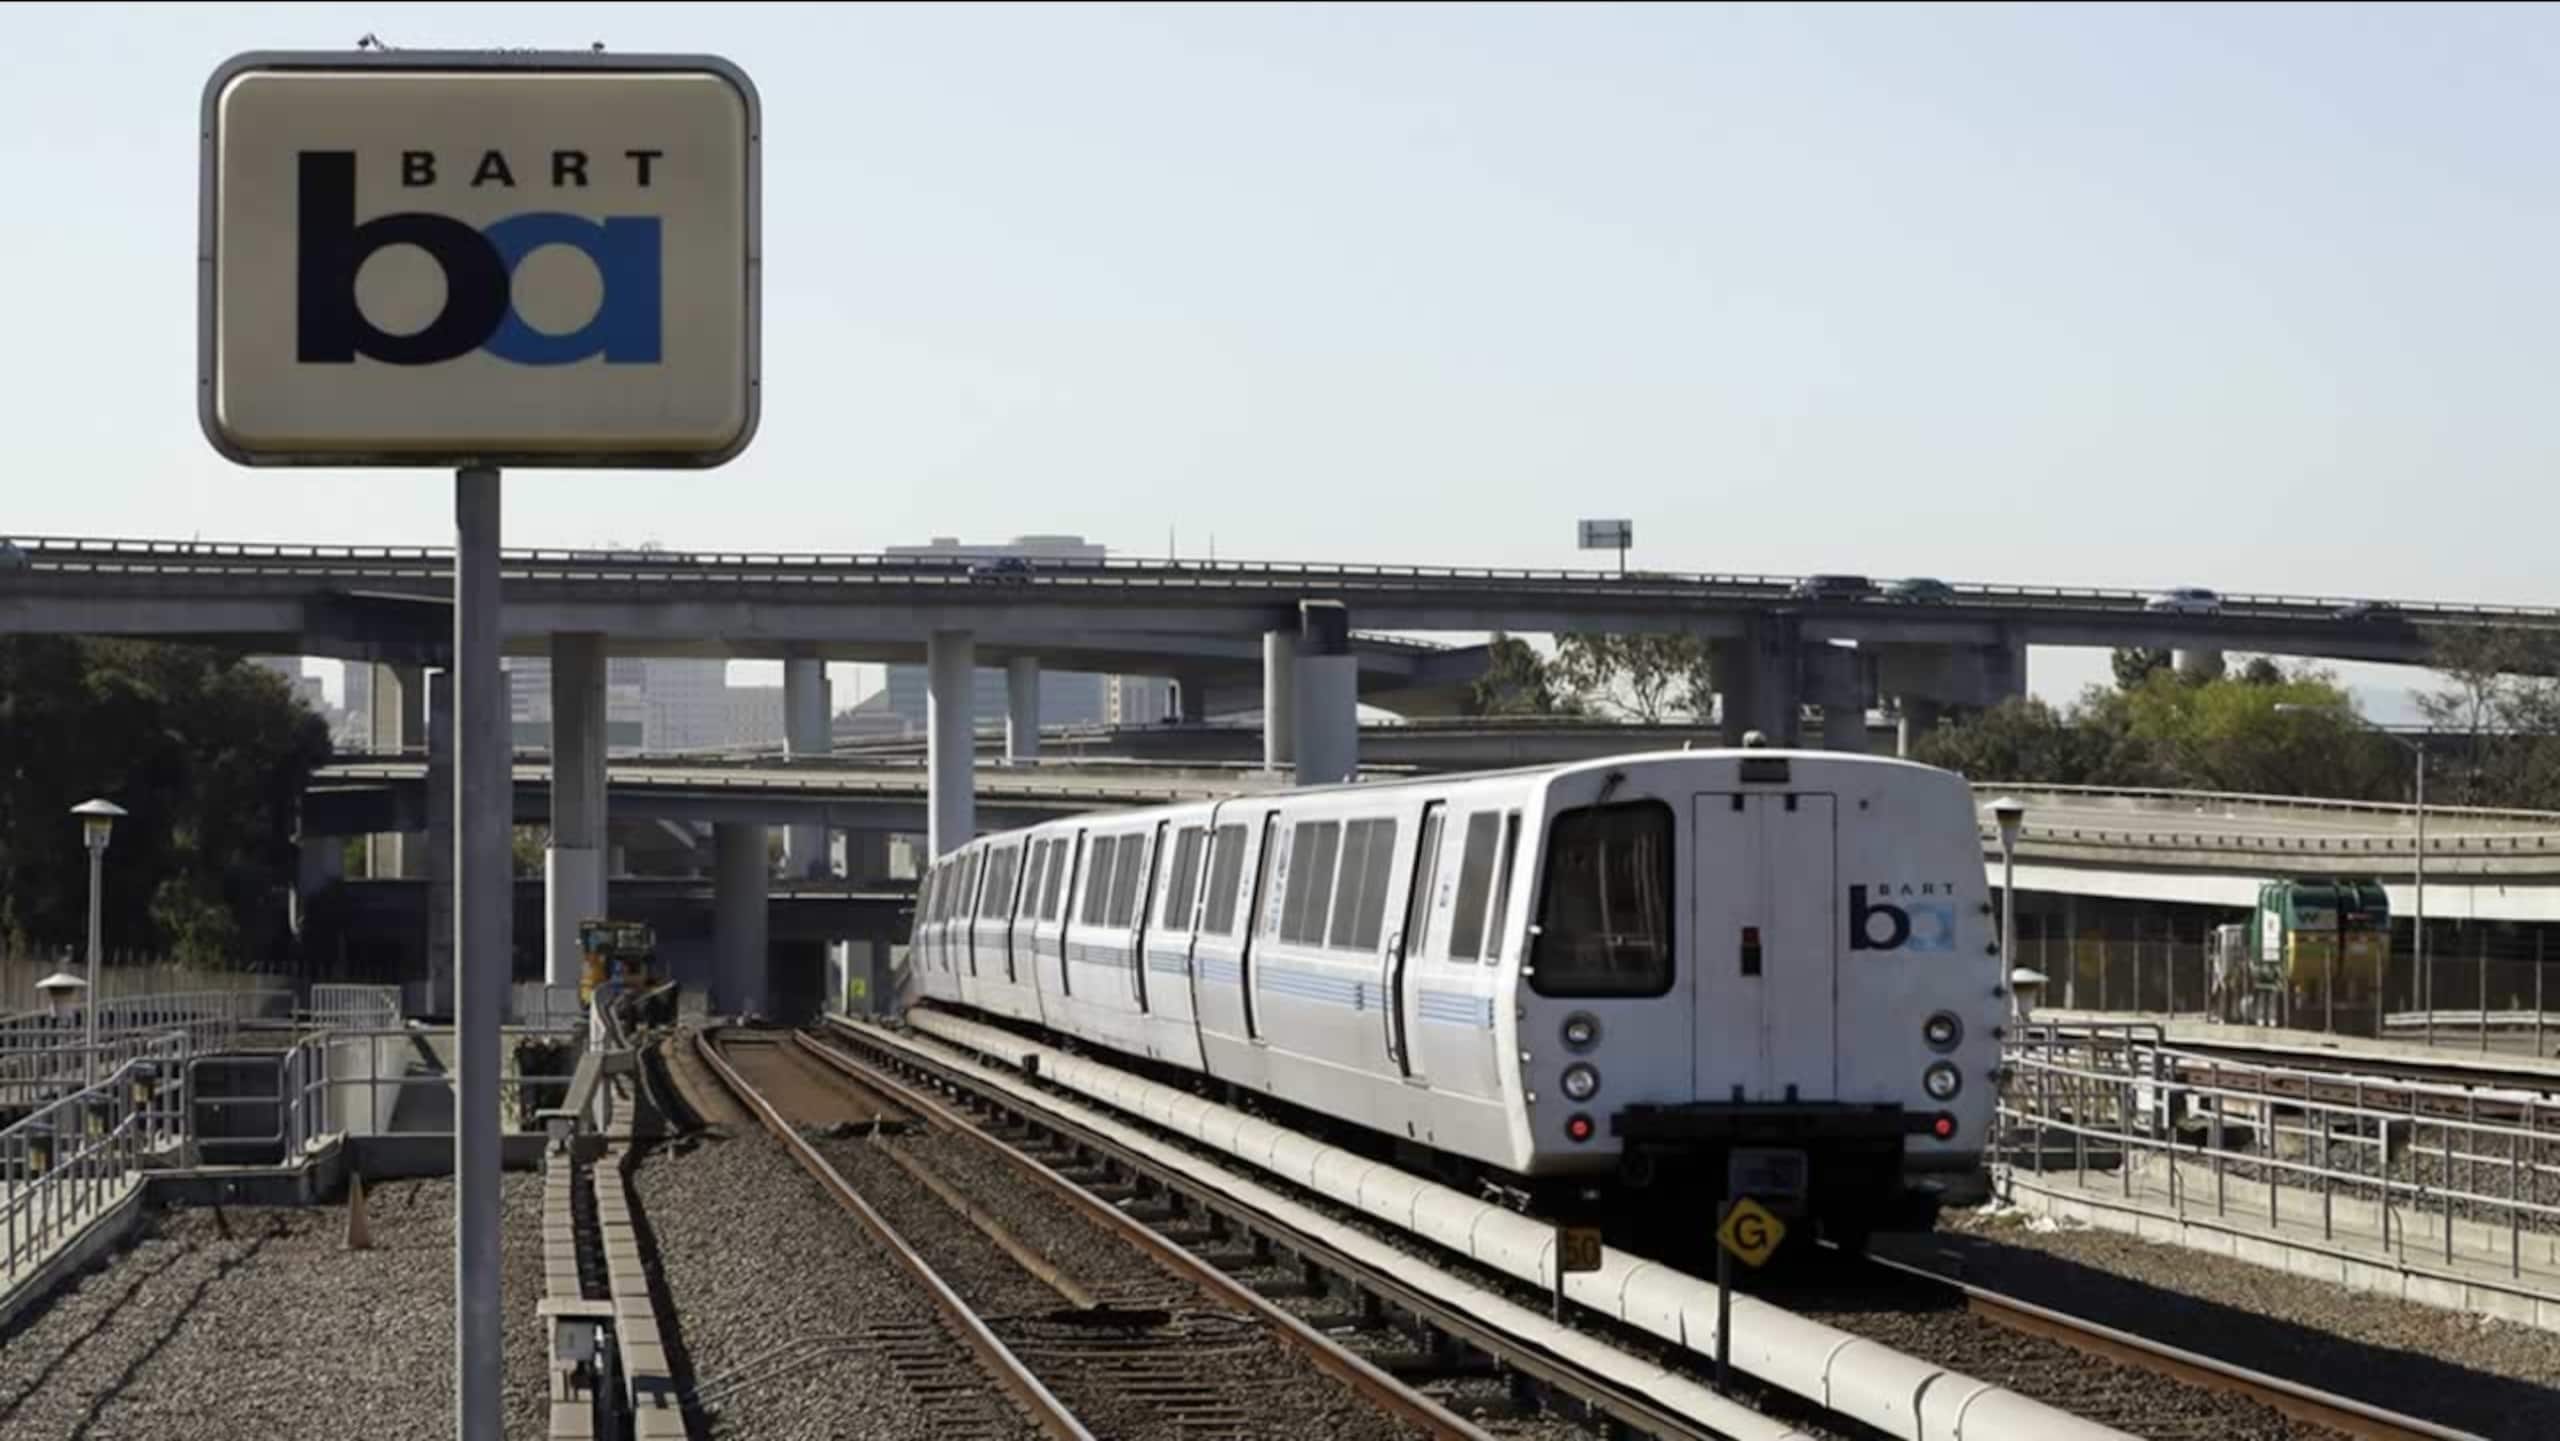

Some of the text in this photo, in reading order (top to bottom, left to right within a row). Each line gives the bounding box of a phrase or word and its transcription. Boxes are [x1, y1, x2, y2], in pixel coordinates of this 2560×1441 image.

[401, 149, 664, 188] BART
[296, 149, 663, 366] ba
[1878, 882, 1954, 896] BART
[1733, 1212, 1768, 1251] G
